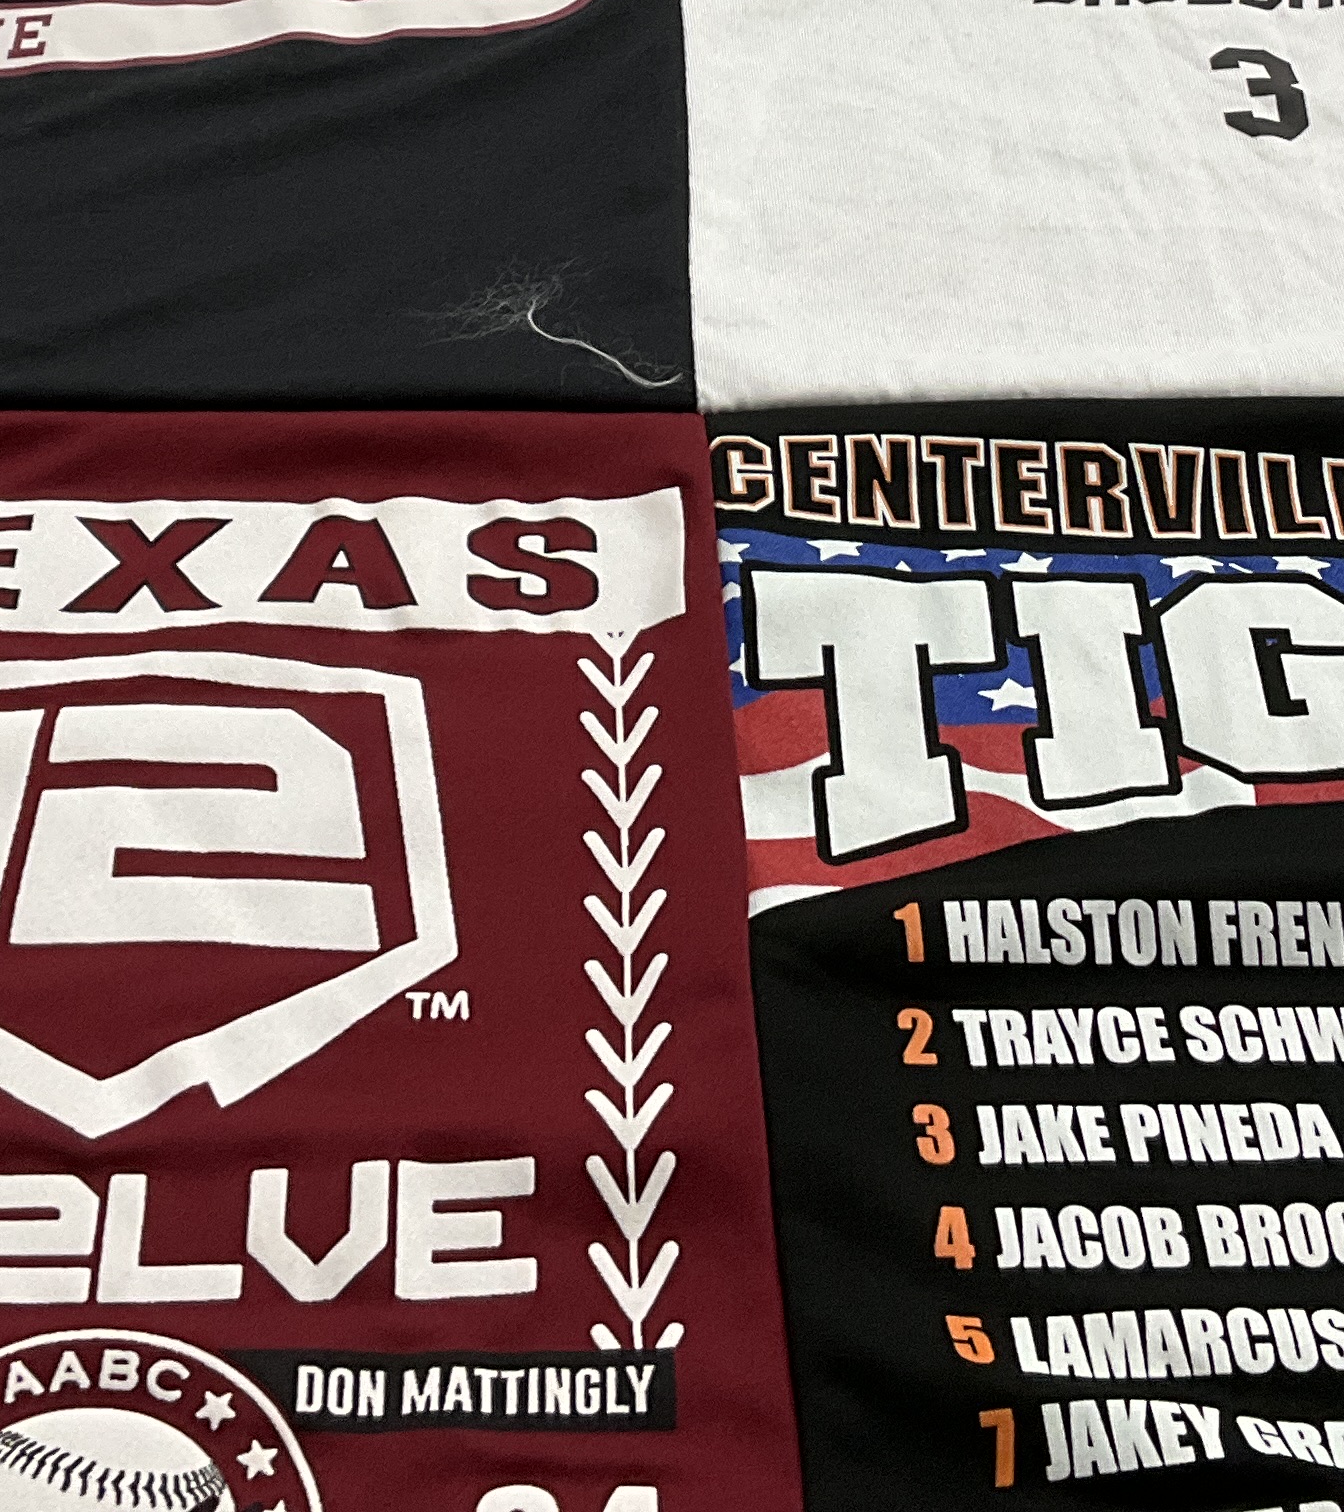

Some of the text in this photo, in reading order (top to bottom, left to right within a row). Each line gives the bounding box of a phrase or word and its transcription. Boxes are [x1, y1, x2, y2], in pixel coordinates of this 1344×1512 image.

[1210, 47, 1310, 141] 3
[893, 902, 925, 963] 1
[943, 898, 1197, 967] HALSTON
[896, 1008, 937, 1065] 2
[953, 1006, 1175, 1067] TRAYCE
[913, 1102, 1344, 1165] 3 JAKE PINEDA
[934, 1205, 975, 1269] 4
[993, 1204, 1190, 1270] JACOB
[945, 1313, 995, 1364] 5
[1, 1350, 193, 1405] AABC
[296, 1363, 656, 1418] DON MATTINGLY
[979, 1407, 1014, 1487] 7
[1040, 1399, 1225, 1482] JAKEY
